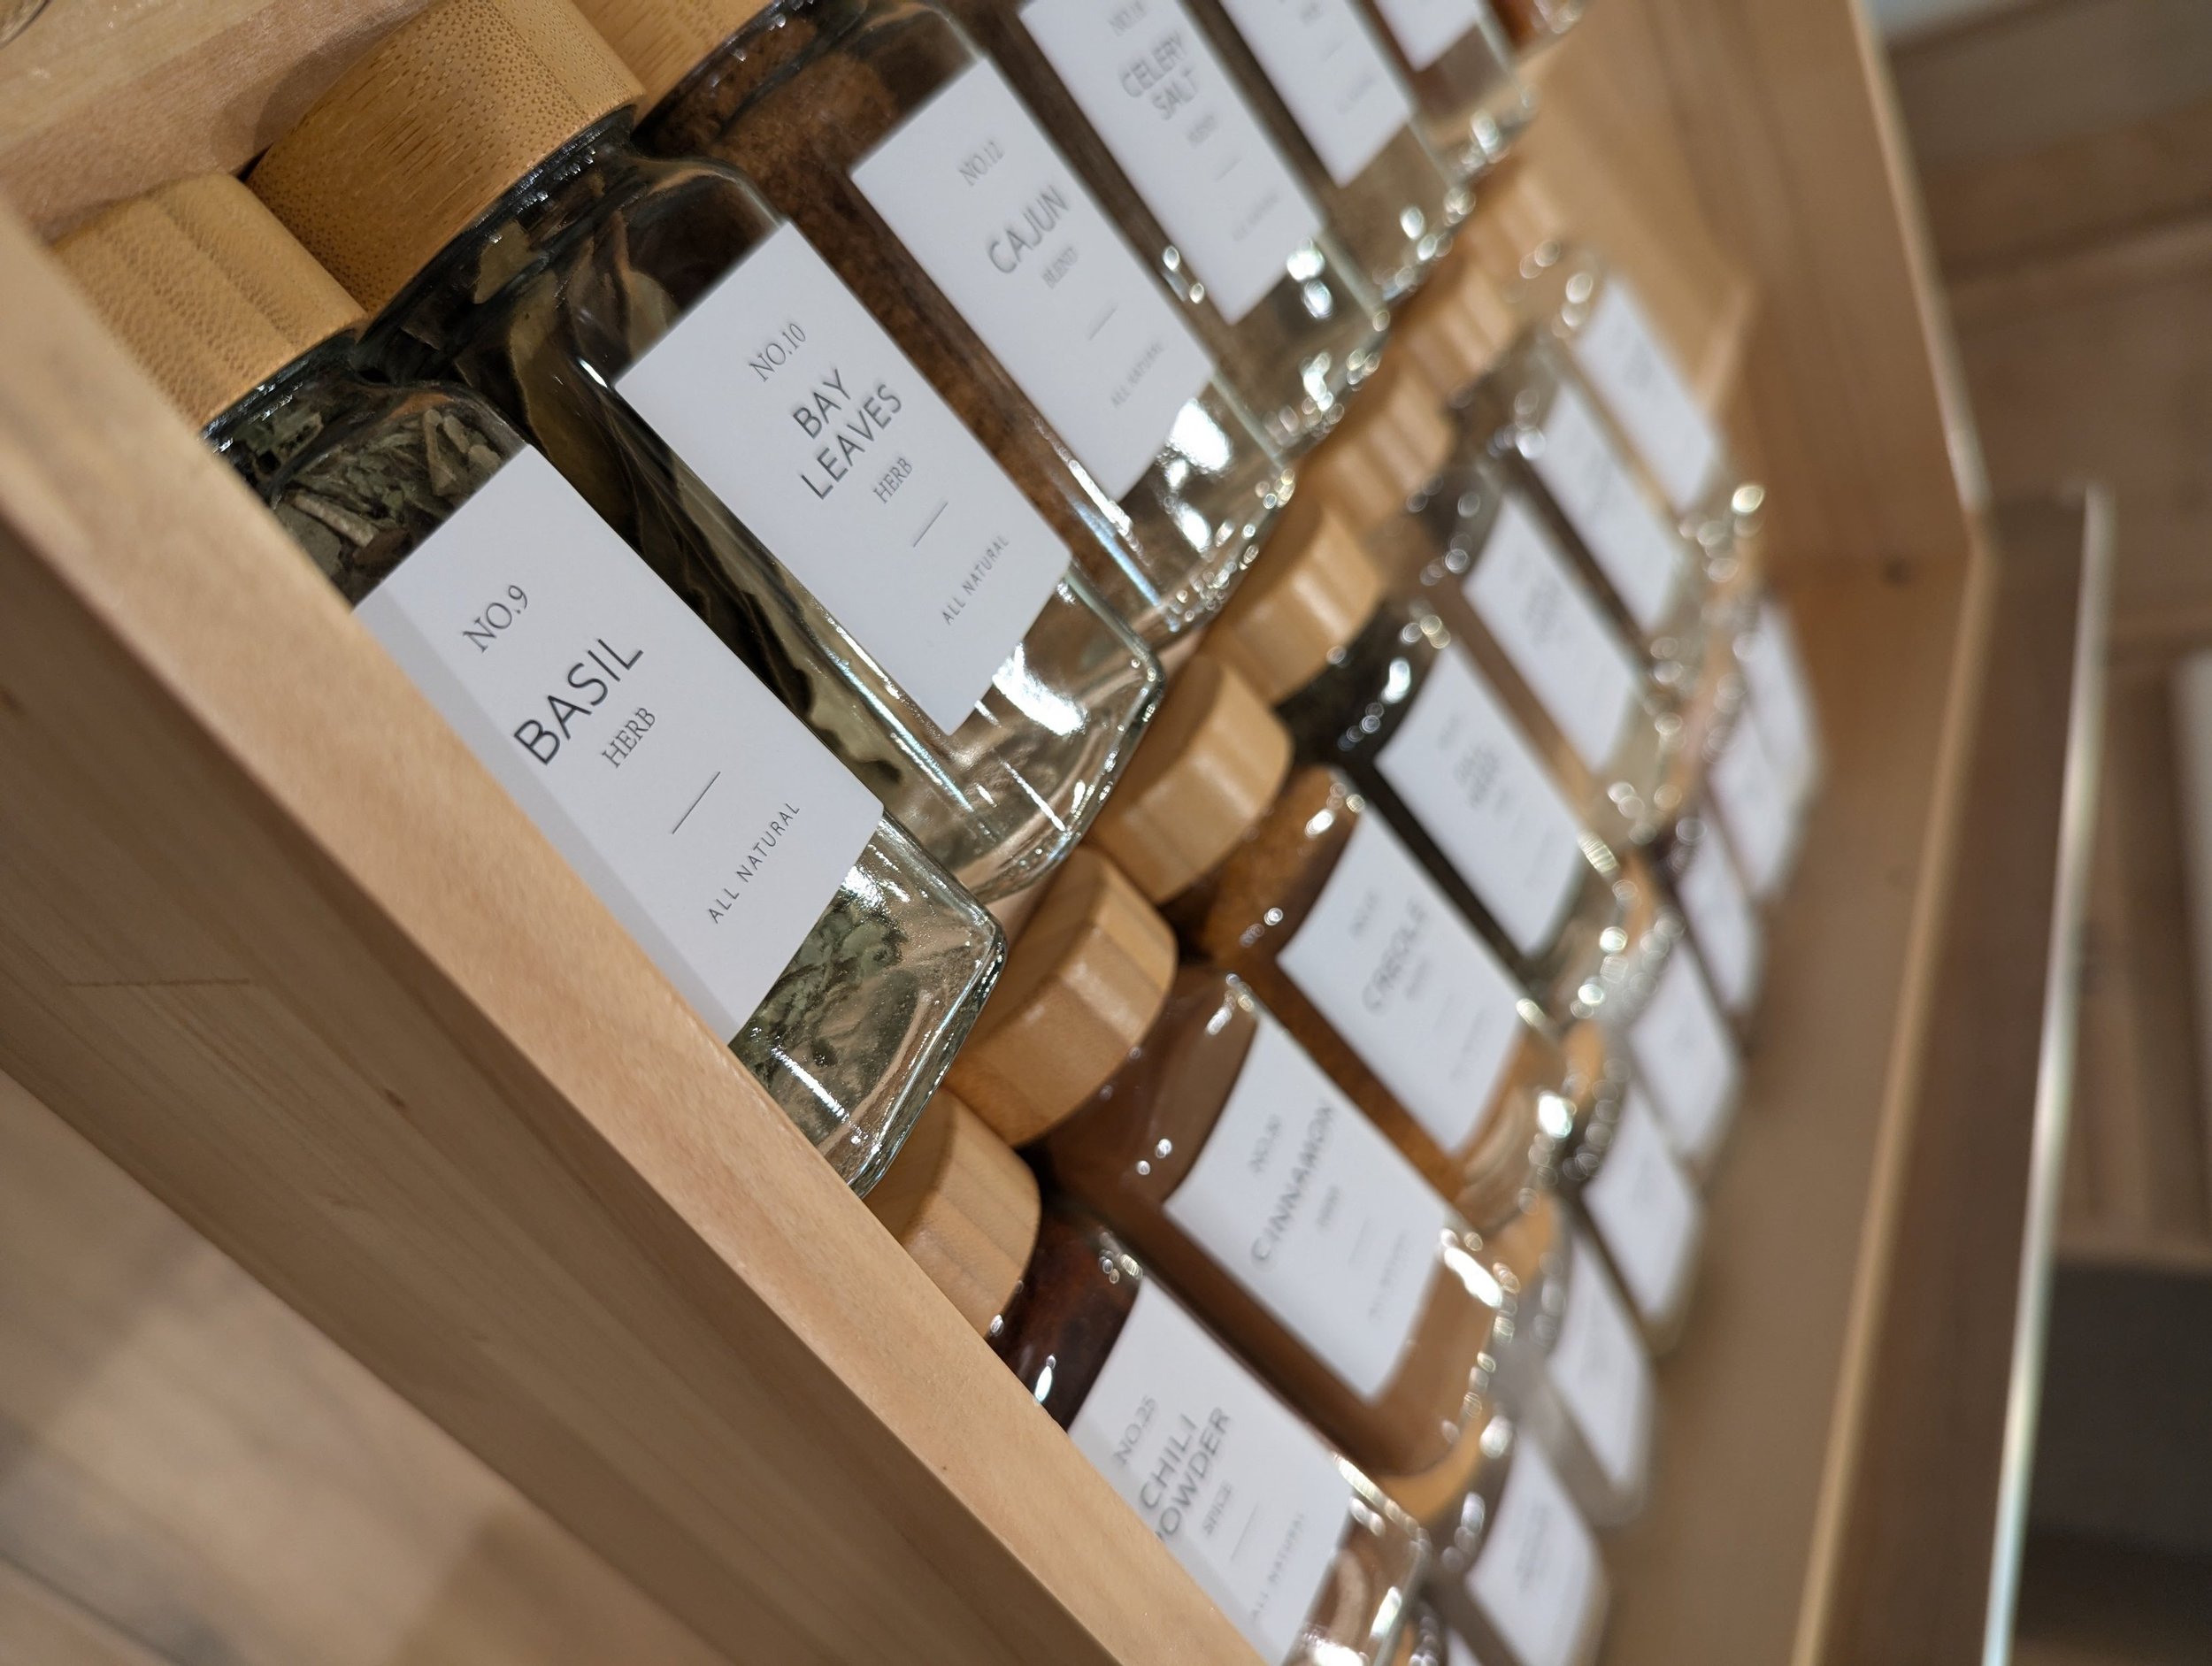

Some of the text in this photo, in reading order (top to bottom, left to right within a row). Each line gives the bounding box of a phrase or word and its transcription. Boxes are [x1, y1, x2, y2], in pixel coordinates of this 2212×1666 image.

[1120, 28, 1187, 98] CELERY
[1151, 66, 1198, 120] SALT
[958, 139, 1004, 186] NO.12
[987, 184, 1069, 273] CAJUN
[749, 322, 806, 382] NO.10
[792, 367, 850, 439] BAY
[800, 383, 902, 500] LEAVES
[872, 457, 913, 503] HERB
[942, 536, 1010, 625] ALL NATURAL
[462, 584, 528, 653] NO.9
[512, 638, 643, 766] BASIL
[602, 707, 656, 768] HERB
[708, 802, 800, 924] ALL NATURAL
[1250, 1099, 1335, 1271] CINNAMON
[1140, 1412, 1197, 1509] CHILI
